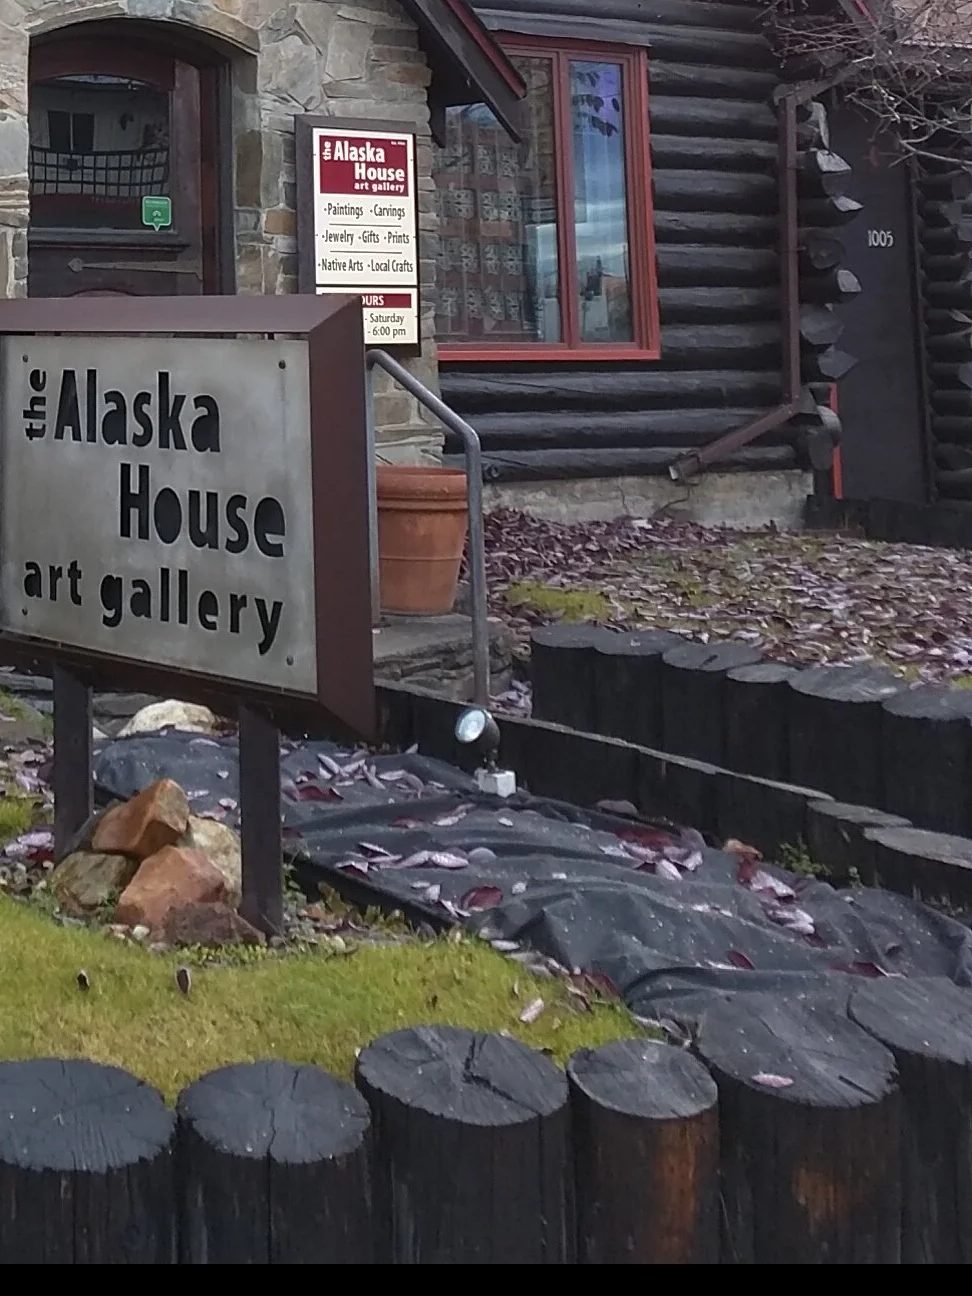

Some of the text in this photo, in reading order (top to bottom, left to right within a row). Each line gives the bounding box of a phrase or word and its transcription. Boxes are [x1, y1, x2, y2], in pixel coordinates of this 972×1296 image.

[322, 140, 385, 163] the Alaska
[354, 162, 405, 182] House
[354, 182, 405, 193] art gallery
[327, 202, 406, 220] Paintings Carvings
[324, 229, 410, 245] Jewelry Gifts Prints
[868, 229, 894, 247] 1005
[321, 258, 414, 272] Native Arts Local Crafts
[369, 312, 405, 326] Saturday
[372, 326, 391, 336] 6:00
[392, 328, 406, 339] pm
[22, 368, 222, 453] the Alaska
[119, 462, 286, 558] House
[23, 559, 284, 655] art gallery
